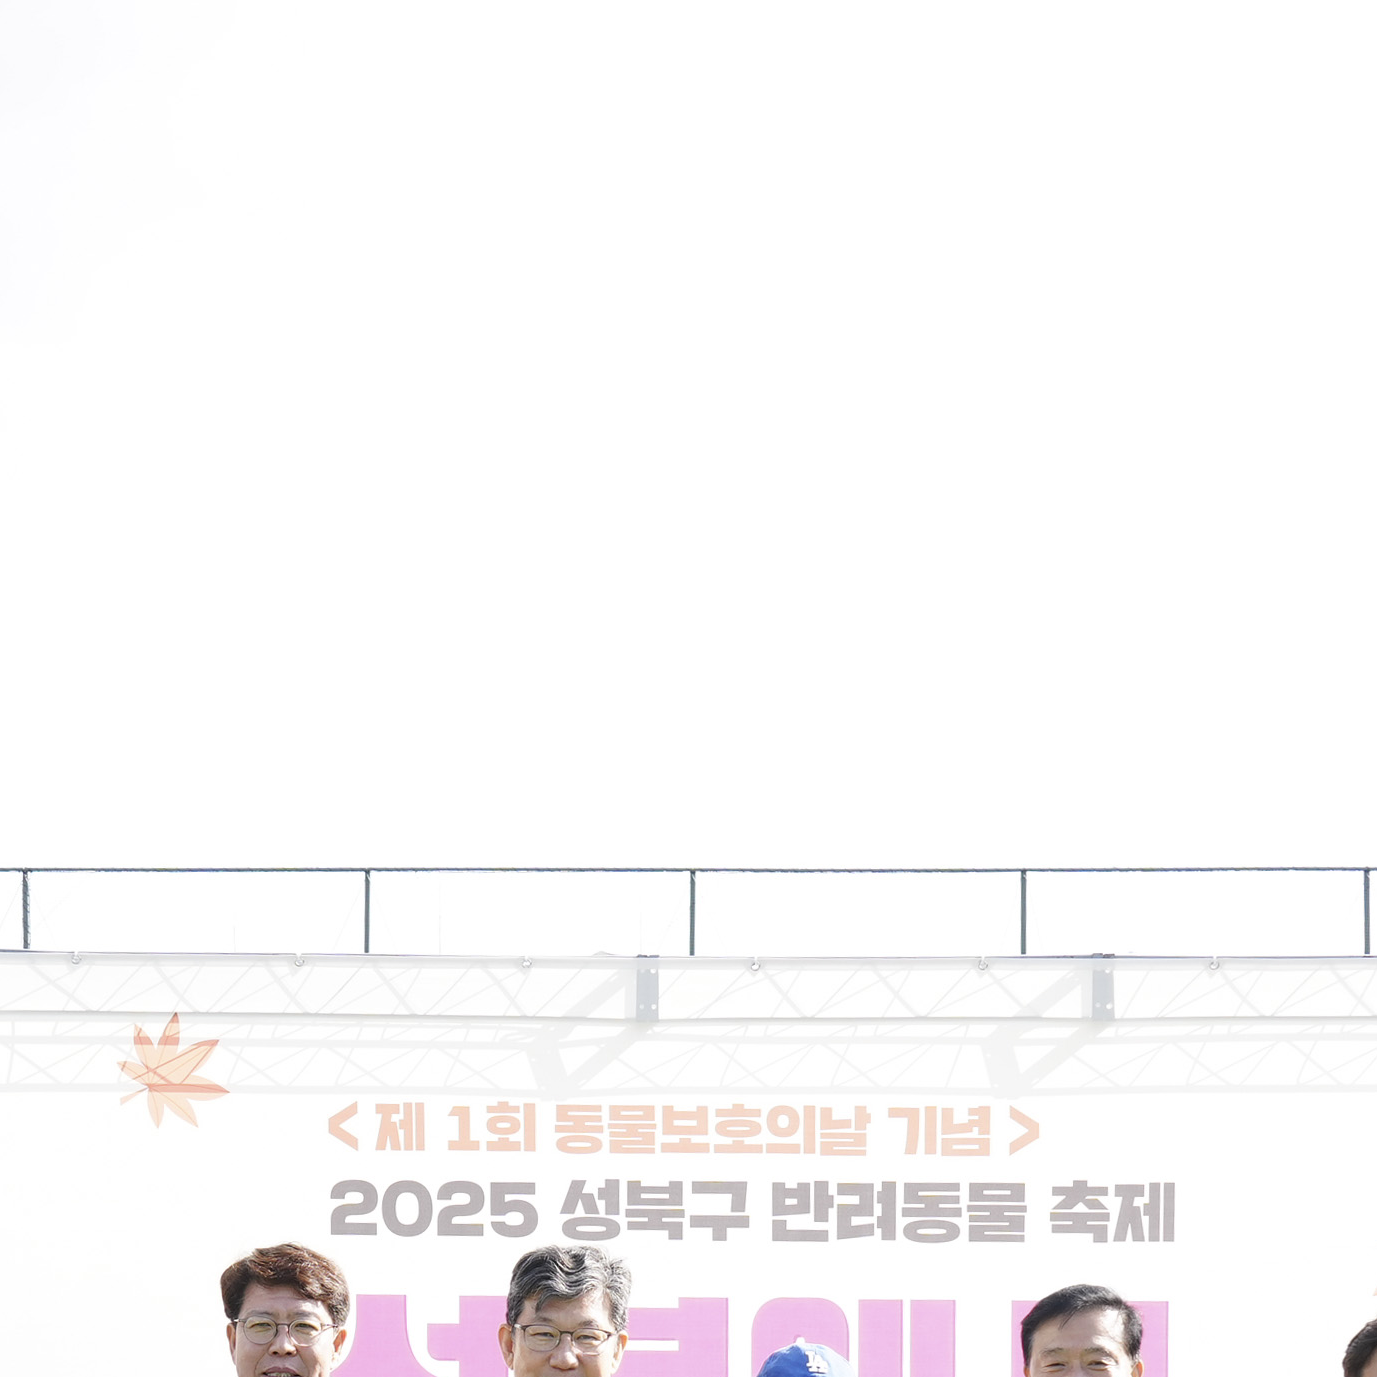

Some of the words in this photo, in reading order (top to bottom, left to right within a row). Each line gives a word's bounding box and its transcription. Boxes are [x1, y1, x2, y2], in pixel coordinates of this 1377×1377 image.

[375, 1101, 425, 1152] 제
[447, 1101, 537, 1152] 1회
[554, 1103, 872, 1157] 동물보호의날
[888, 1105, 991, 1156] 기념
[330, 1179, 539, 1238] 2025
[559, 1178, 750, 1242] 성북구
[771, 1180, 1028, 1244] 반려동물
[1049, 1179, 1176, 1244] 축제
[805, 1350, 829, 1373] LA
